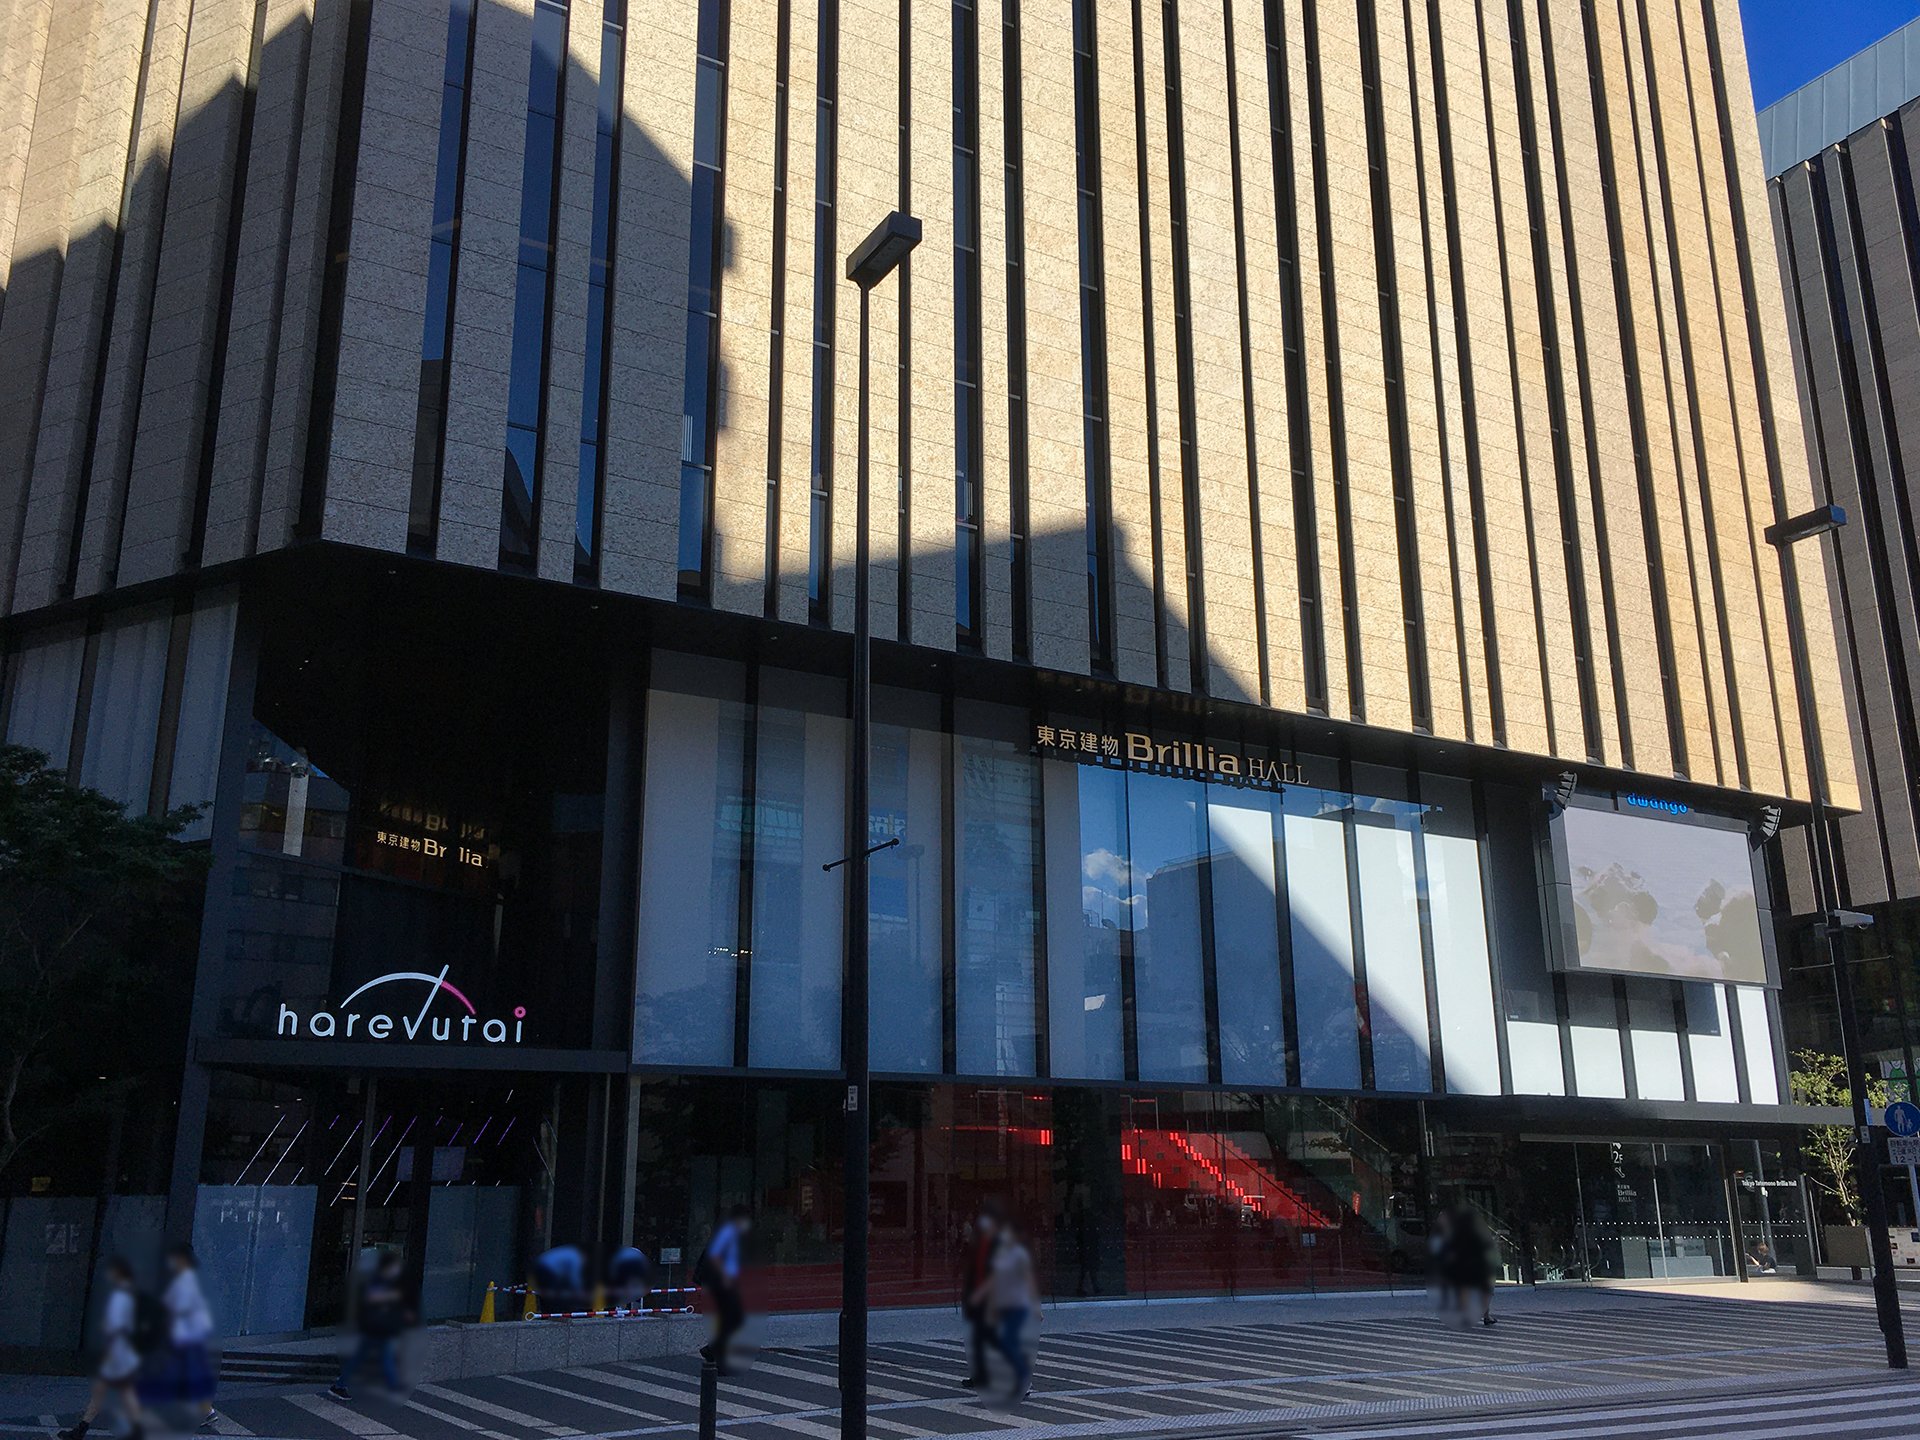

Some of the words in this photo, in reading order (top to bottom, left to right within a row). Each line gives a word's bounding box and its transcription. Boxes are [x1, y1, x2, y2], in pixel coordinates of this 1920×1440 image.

[1036, 725, 1119, 757] 東京建物
[1125, 732, 1241, 775] Brillia
[1247, 757, 1310, 785] HALL
[1626, 792, 1688, 815] dwango
[376, 831, 420, 853] 東京建物
[1613, 1150, 1623, 1163] 2F
